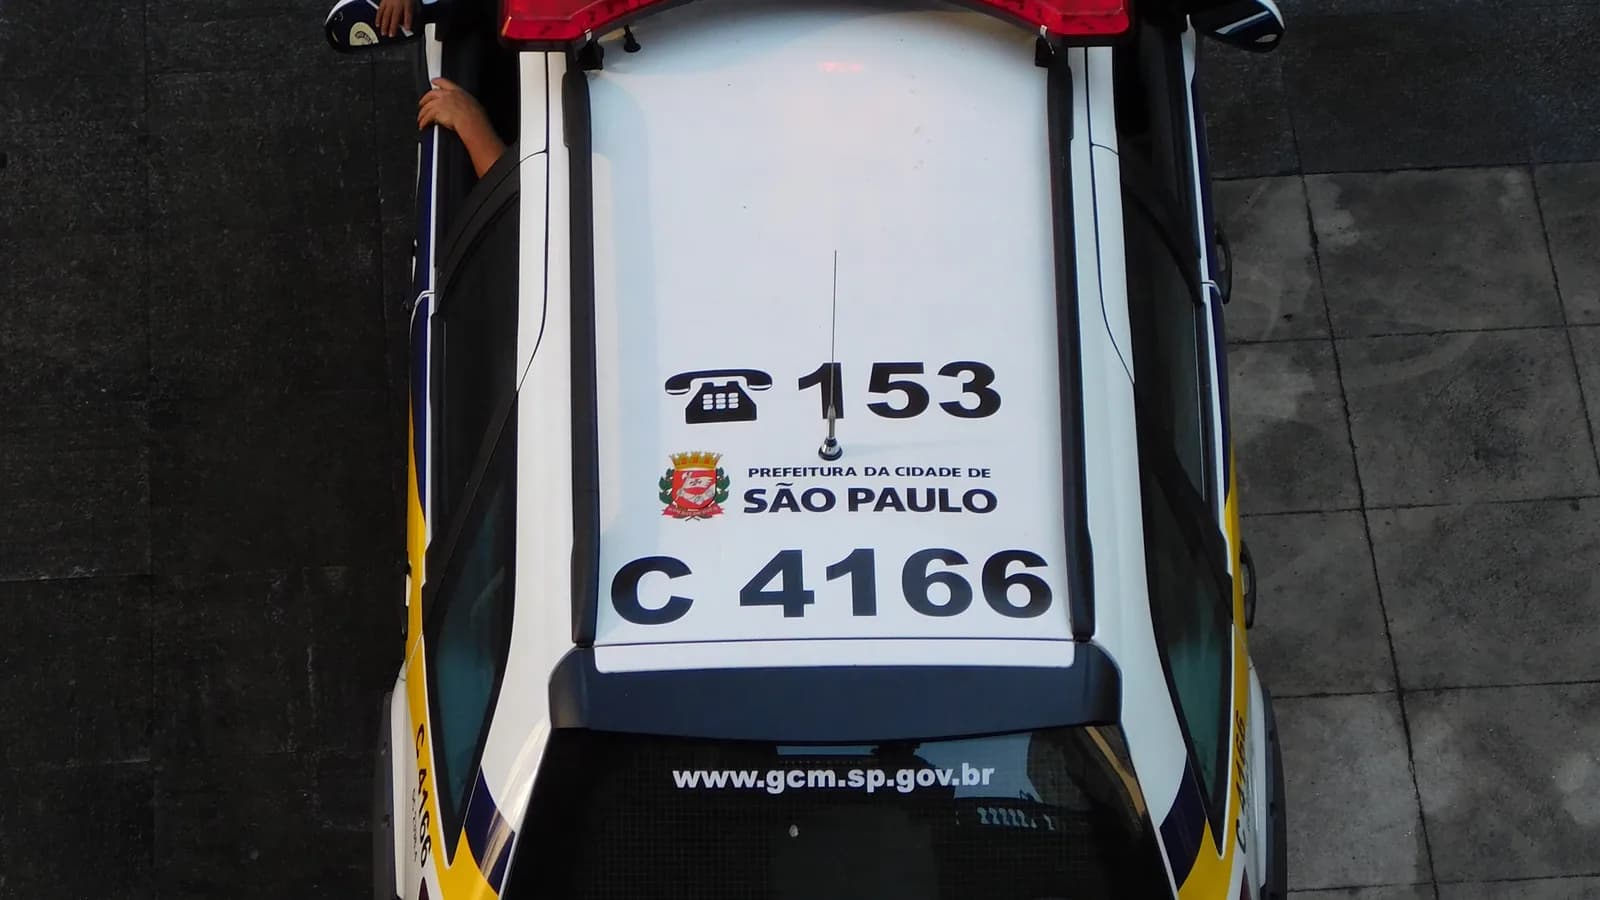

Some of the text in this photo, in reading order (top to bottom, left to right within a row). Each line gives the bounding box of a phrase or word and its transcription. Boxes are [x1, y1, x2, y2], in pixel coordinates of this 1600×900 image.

[798, 360, 1002, 419] 153
[748, 466, 991, 478] PREFEITURA DA CIDADE DE
[743, 482, 837, 514] SÃO
[847, 487, 998, 514] PAULO
[610, 548, 1053, 624] C 4166
[415, 723, 432, 868] C 4166
[672, 762, 996, 794] www.gcm.sp.gov.br
